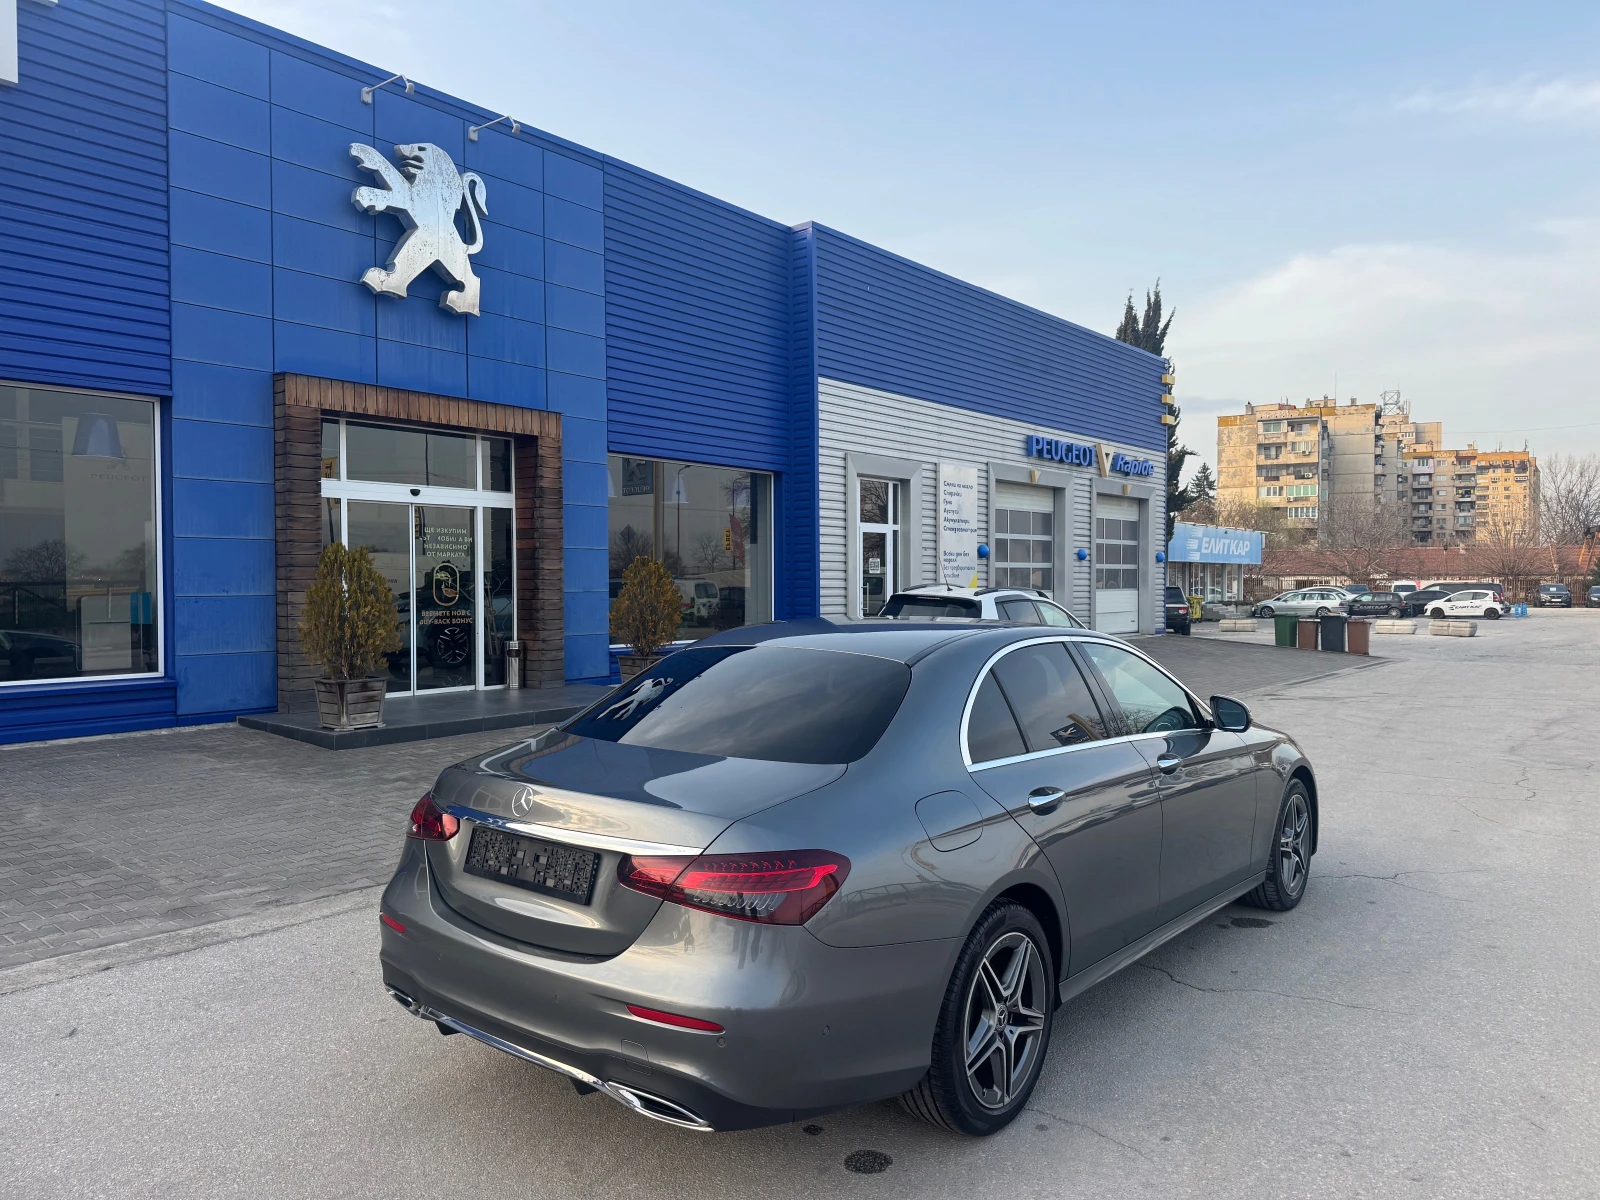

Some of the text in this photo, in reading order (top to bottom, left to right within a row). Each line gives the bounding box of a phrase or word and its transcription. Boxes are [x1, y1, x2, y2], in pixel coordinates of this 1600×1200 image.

[1027, 435, 1155, 476] PEUGEOT Rapide
[90, 473, 148, 481] PEUGEOT
[1201, 537, 1251, 556] ЕЛИТ КАР
